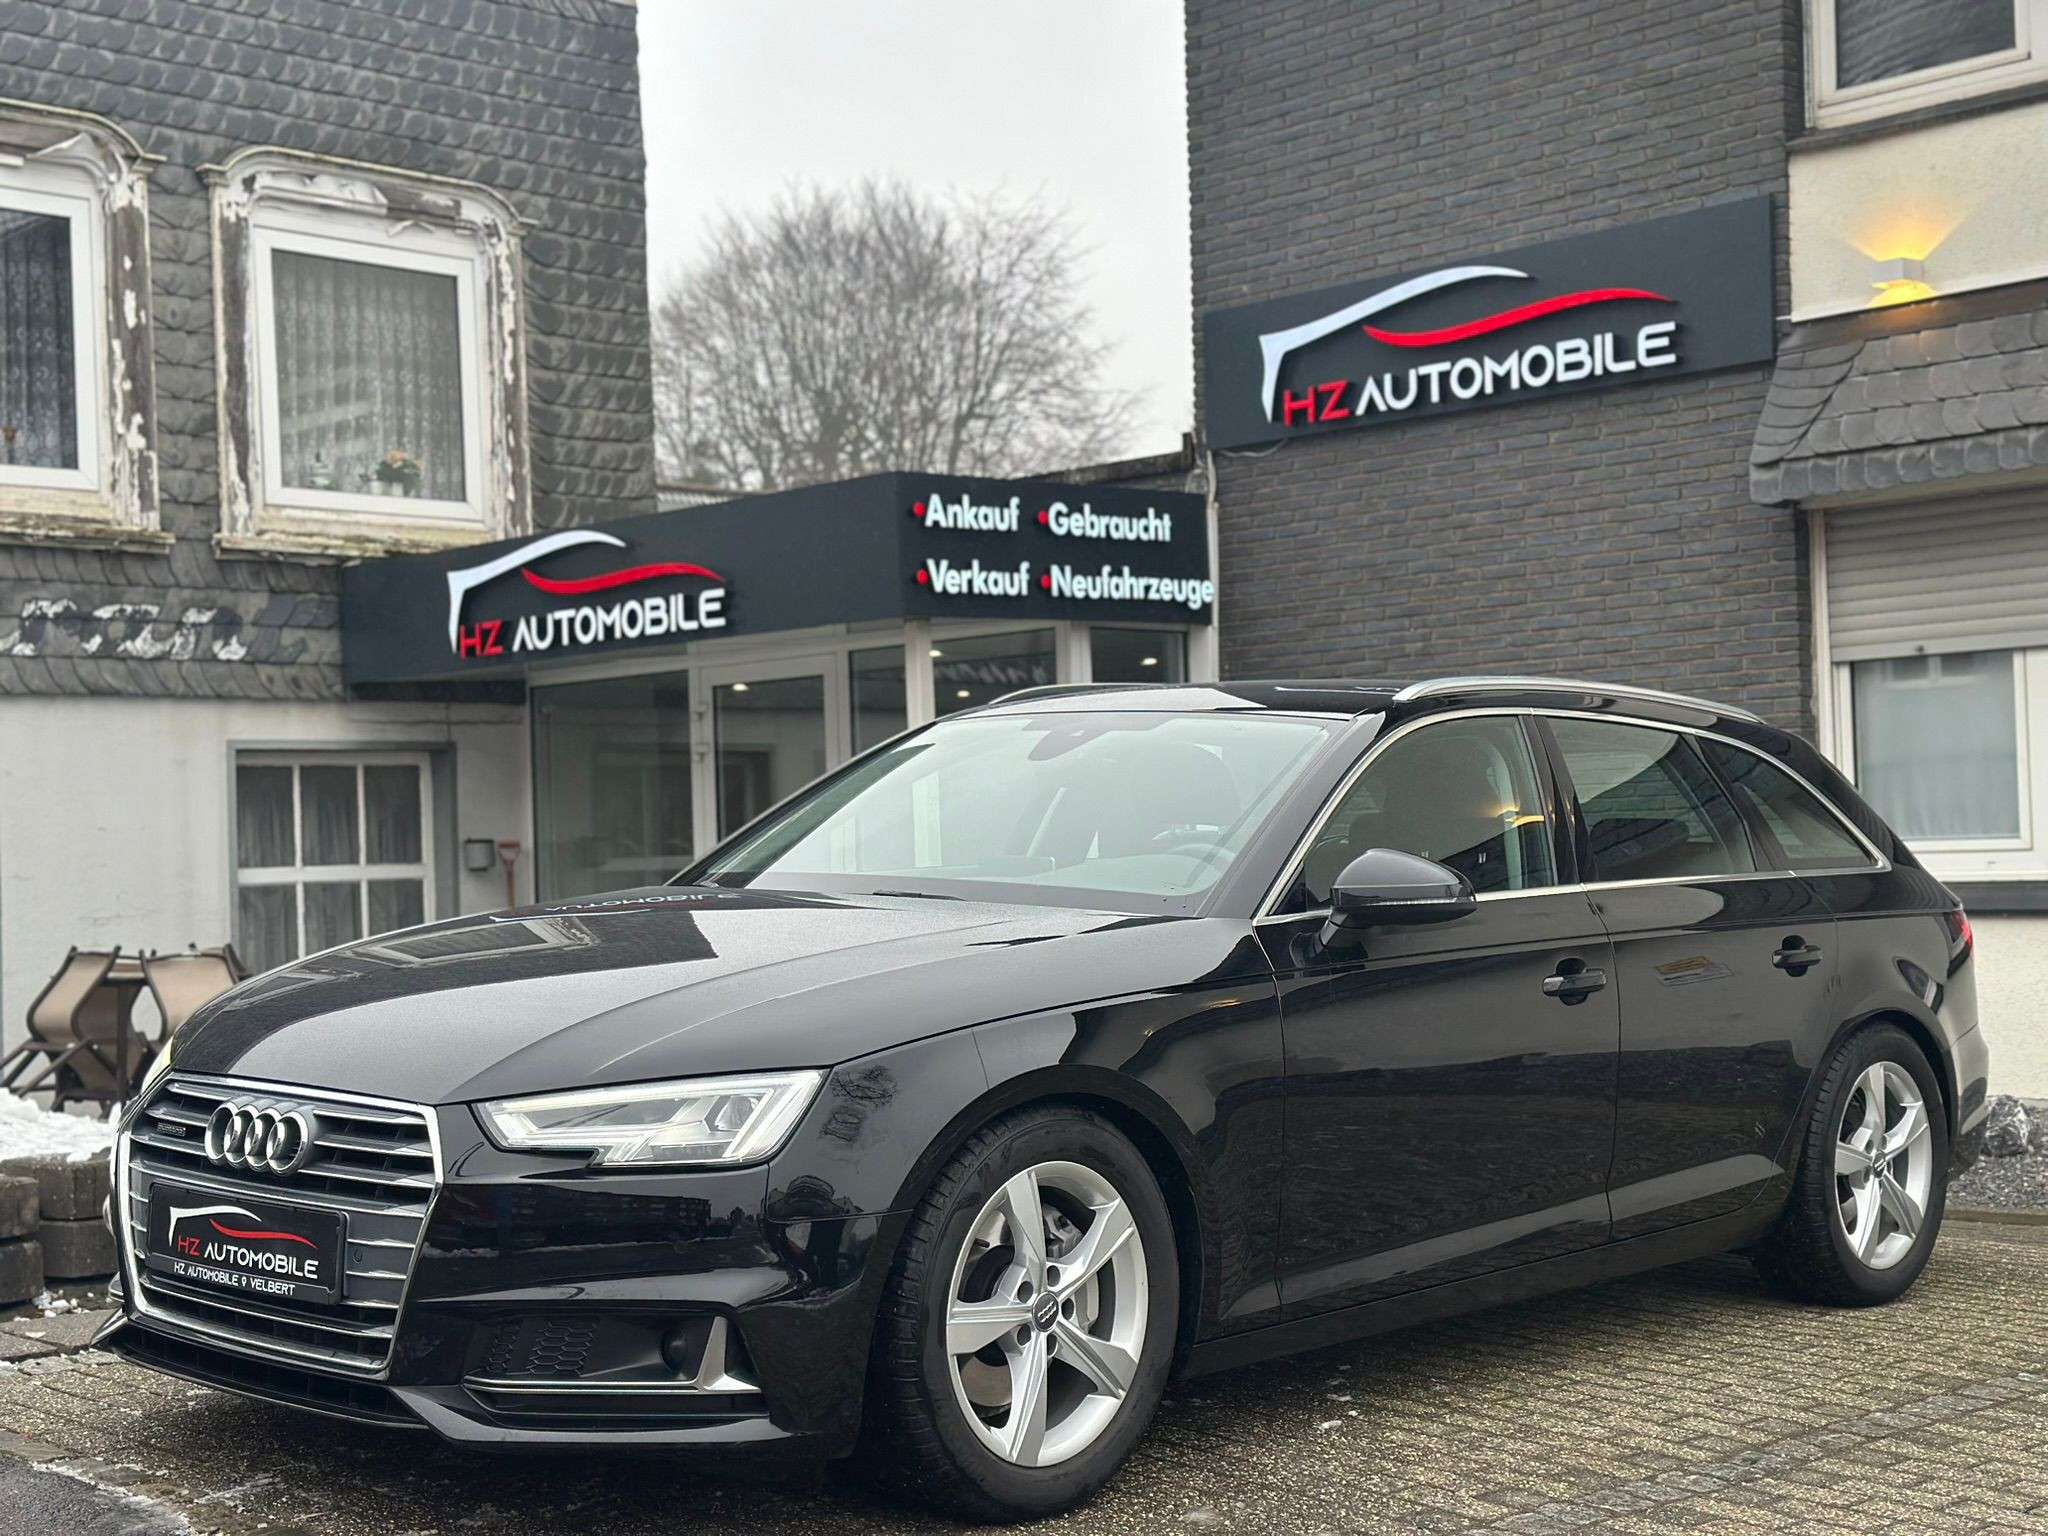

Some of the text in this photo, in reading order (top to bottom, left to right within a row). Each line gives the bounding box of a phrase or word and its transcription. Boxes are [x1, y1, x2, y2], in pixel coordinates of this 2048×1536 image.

[1282, 320, 1677, 427] HZ AUTOMOBILE
[924, 493, 1172, 543] Ankauf Gebraucht
[926, 558, 1215, 610] Verkauf Neufahrzeuge
[458, 587, 727, 660] HZ AUTOMOBILE
[174, 1263, 296, 1296] HZ AUTOMOBILE VELBERT
[177, 1235, 319, 1279] HZ AUTOMOBILE
